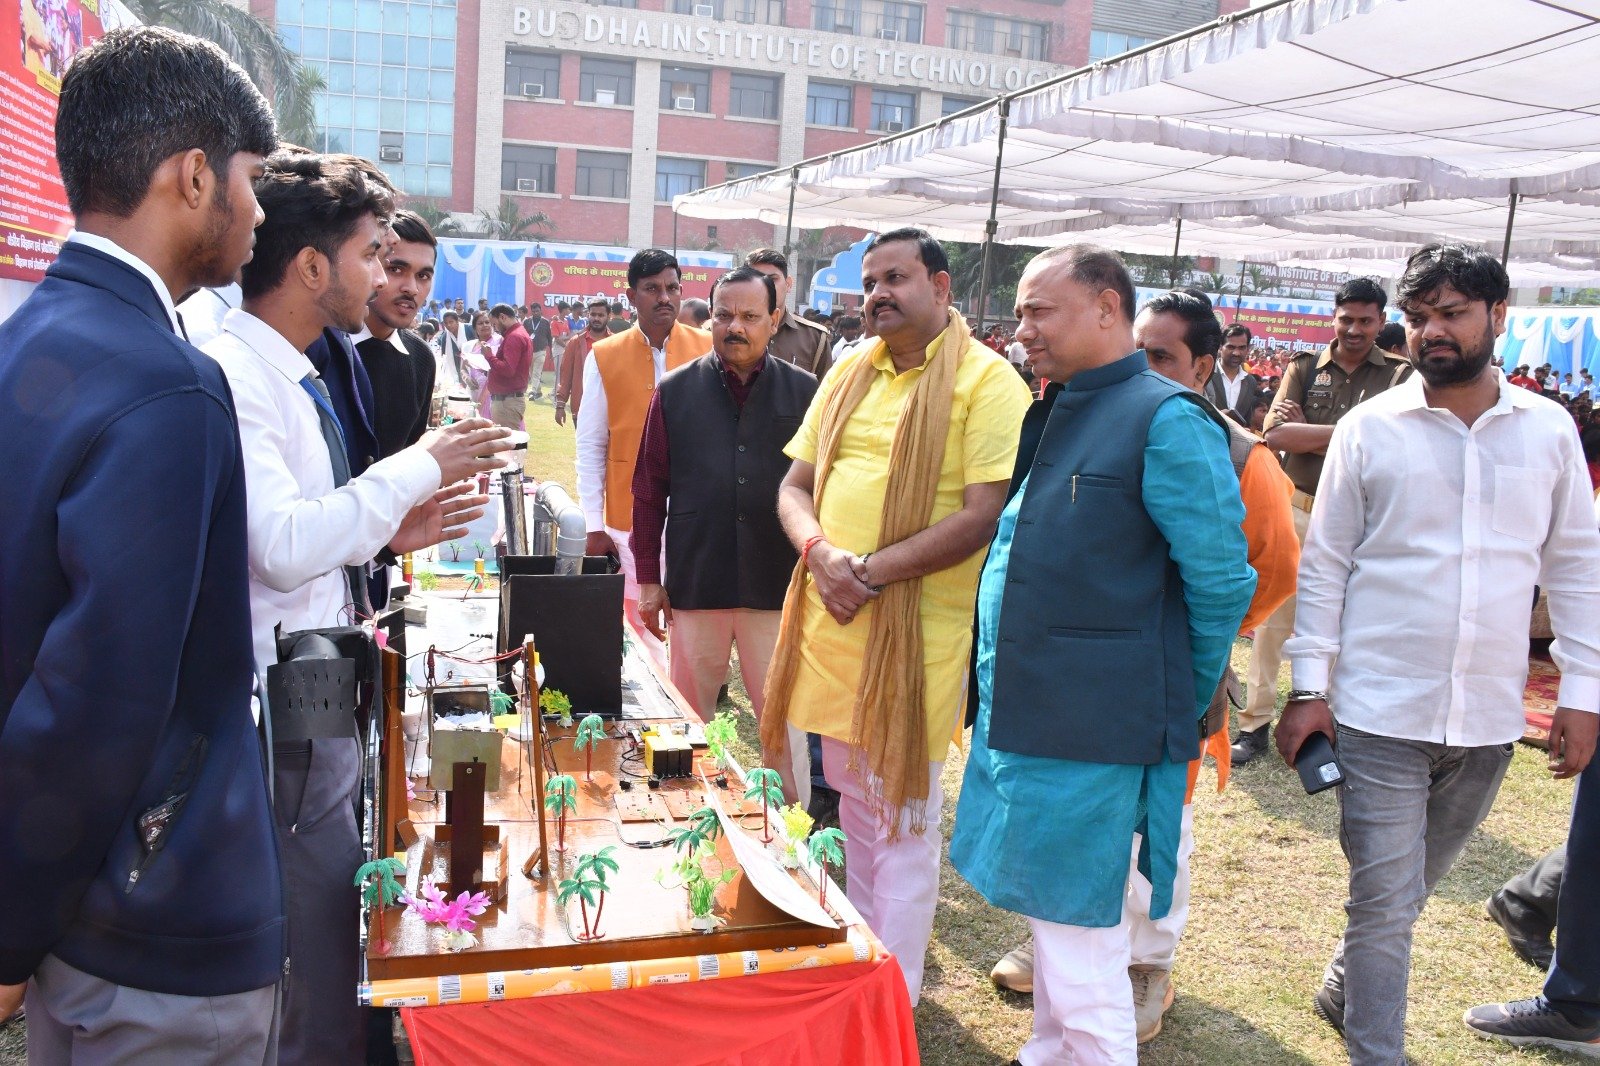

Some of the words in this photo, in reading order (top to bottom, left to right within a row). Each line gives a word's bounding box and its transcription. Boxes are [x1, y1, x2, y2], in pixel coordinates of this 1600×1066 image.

[513, 7, 651, 48] BUDHA
[661, 21, 822, 67] INSTITUTE
[830, 42, 867, 72] OF
[564, 265, 588, 275] परिषद
[590, 267, 598, 275] के
[696, 273, 708, 282] वर्ष
[1279, 267, 1318, 281] INSTITUTE
[1320, 271, 1331, 282] OF
